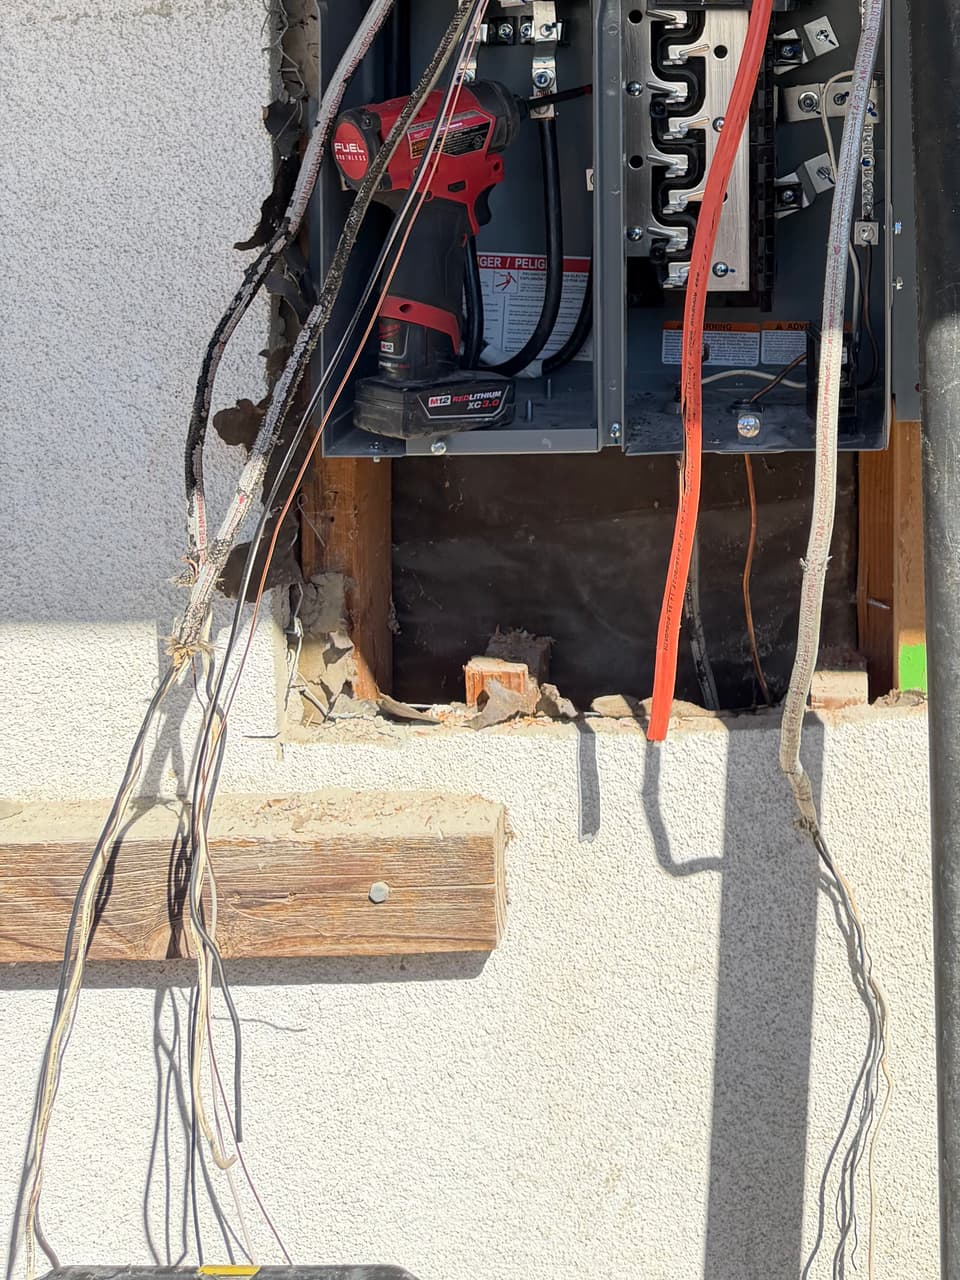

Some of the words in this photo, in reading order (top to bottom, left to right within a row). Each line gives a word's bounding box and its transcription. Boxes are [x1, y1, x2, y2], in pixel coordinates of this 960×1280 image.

[334, 143, 365, 153] FUEL
[429, 395, 451, 407] M12
[452, 391, 502, 403] REDLITHIUM
